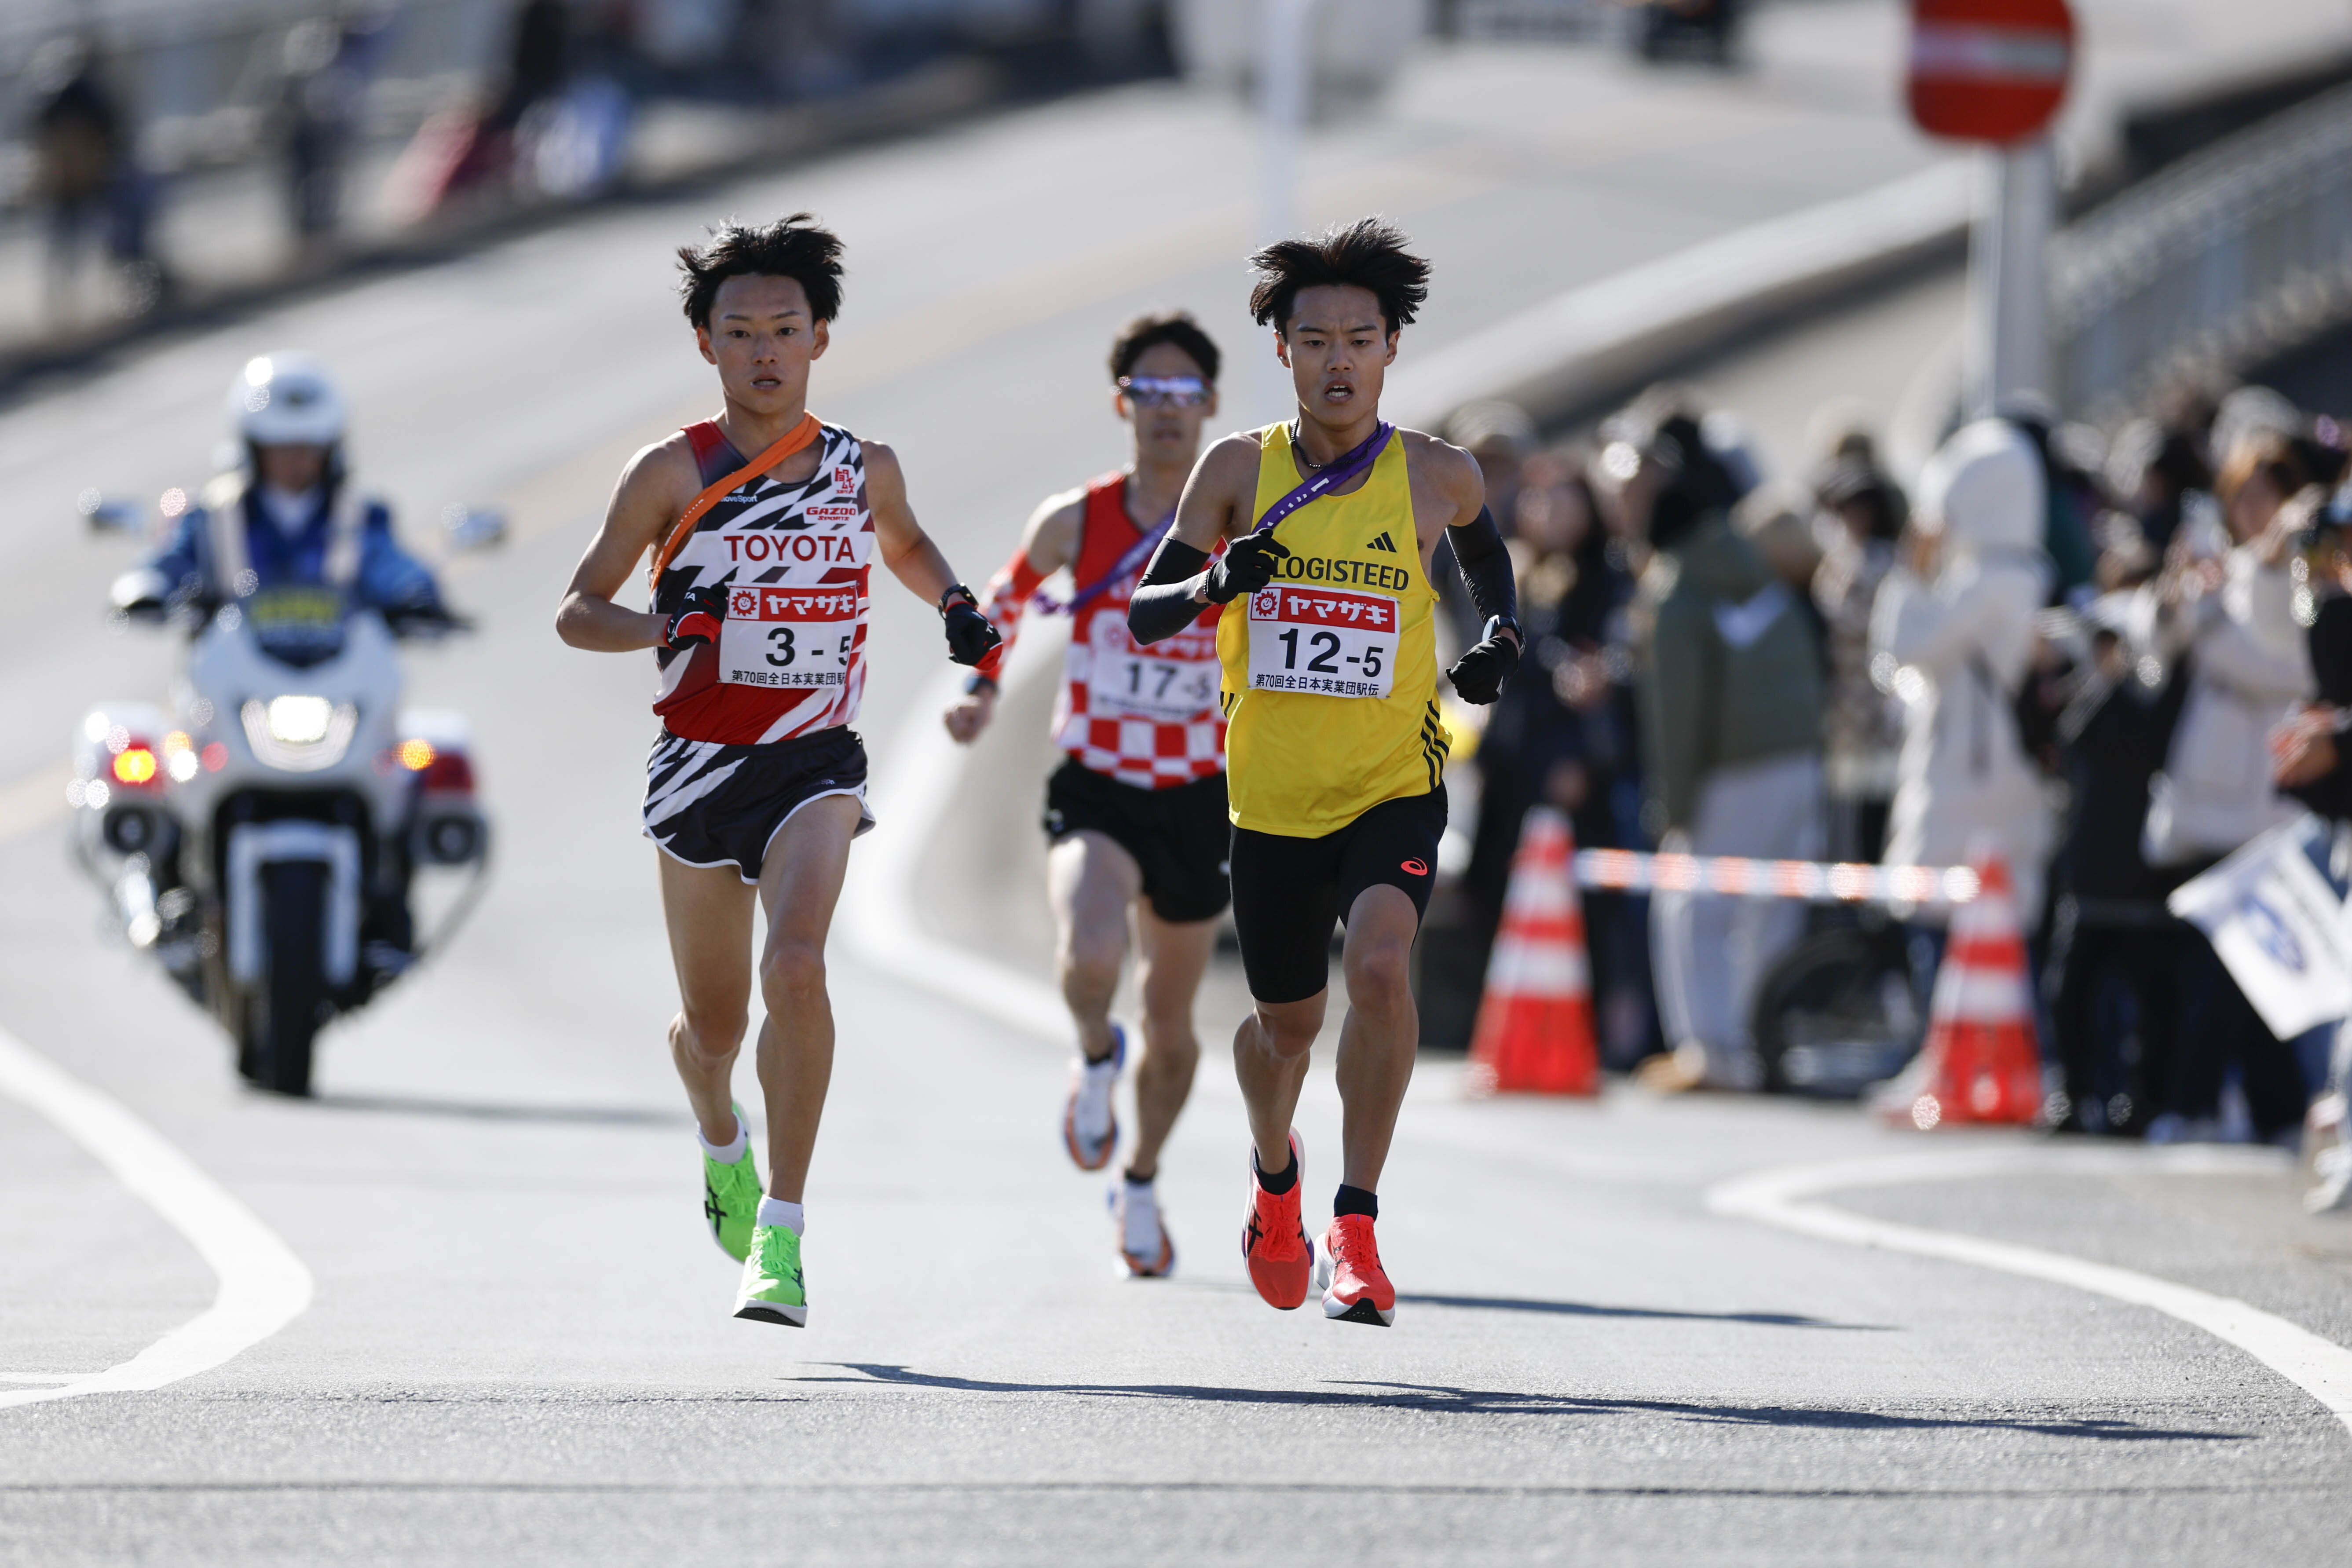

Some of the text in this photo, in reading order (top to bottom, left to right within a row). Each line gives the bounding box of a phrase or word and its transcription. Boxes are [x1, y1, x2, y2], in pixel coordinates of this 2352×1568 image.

[806, 507, 856, 515] GAZOO
[723, 535, 856, 563] TOYOTA
[1273, 556, 1409, 591] LOGISTEED
[766, 594, 854, 615] ヤマザキ
[1287, 596, 1388, 625] ヤマザキ
[1279, 628, 1384, 677] 12-5
[1256, 673, 1379, 696] 第70回全日本実業団駅伝
